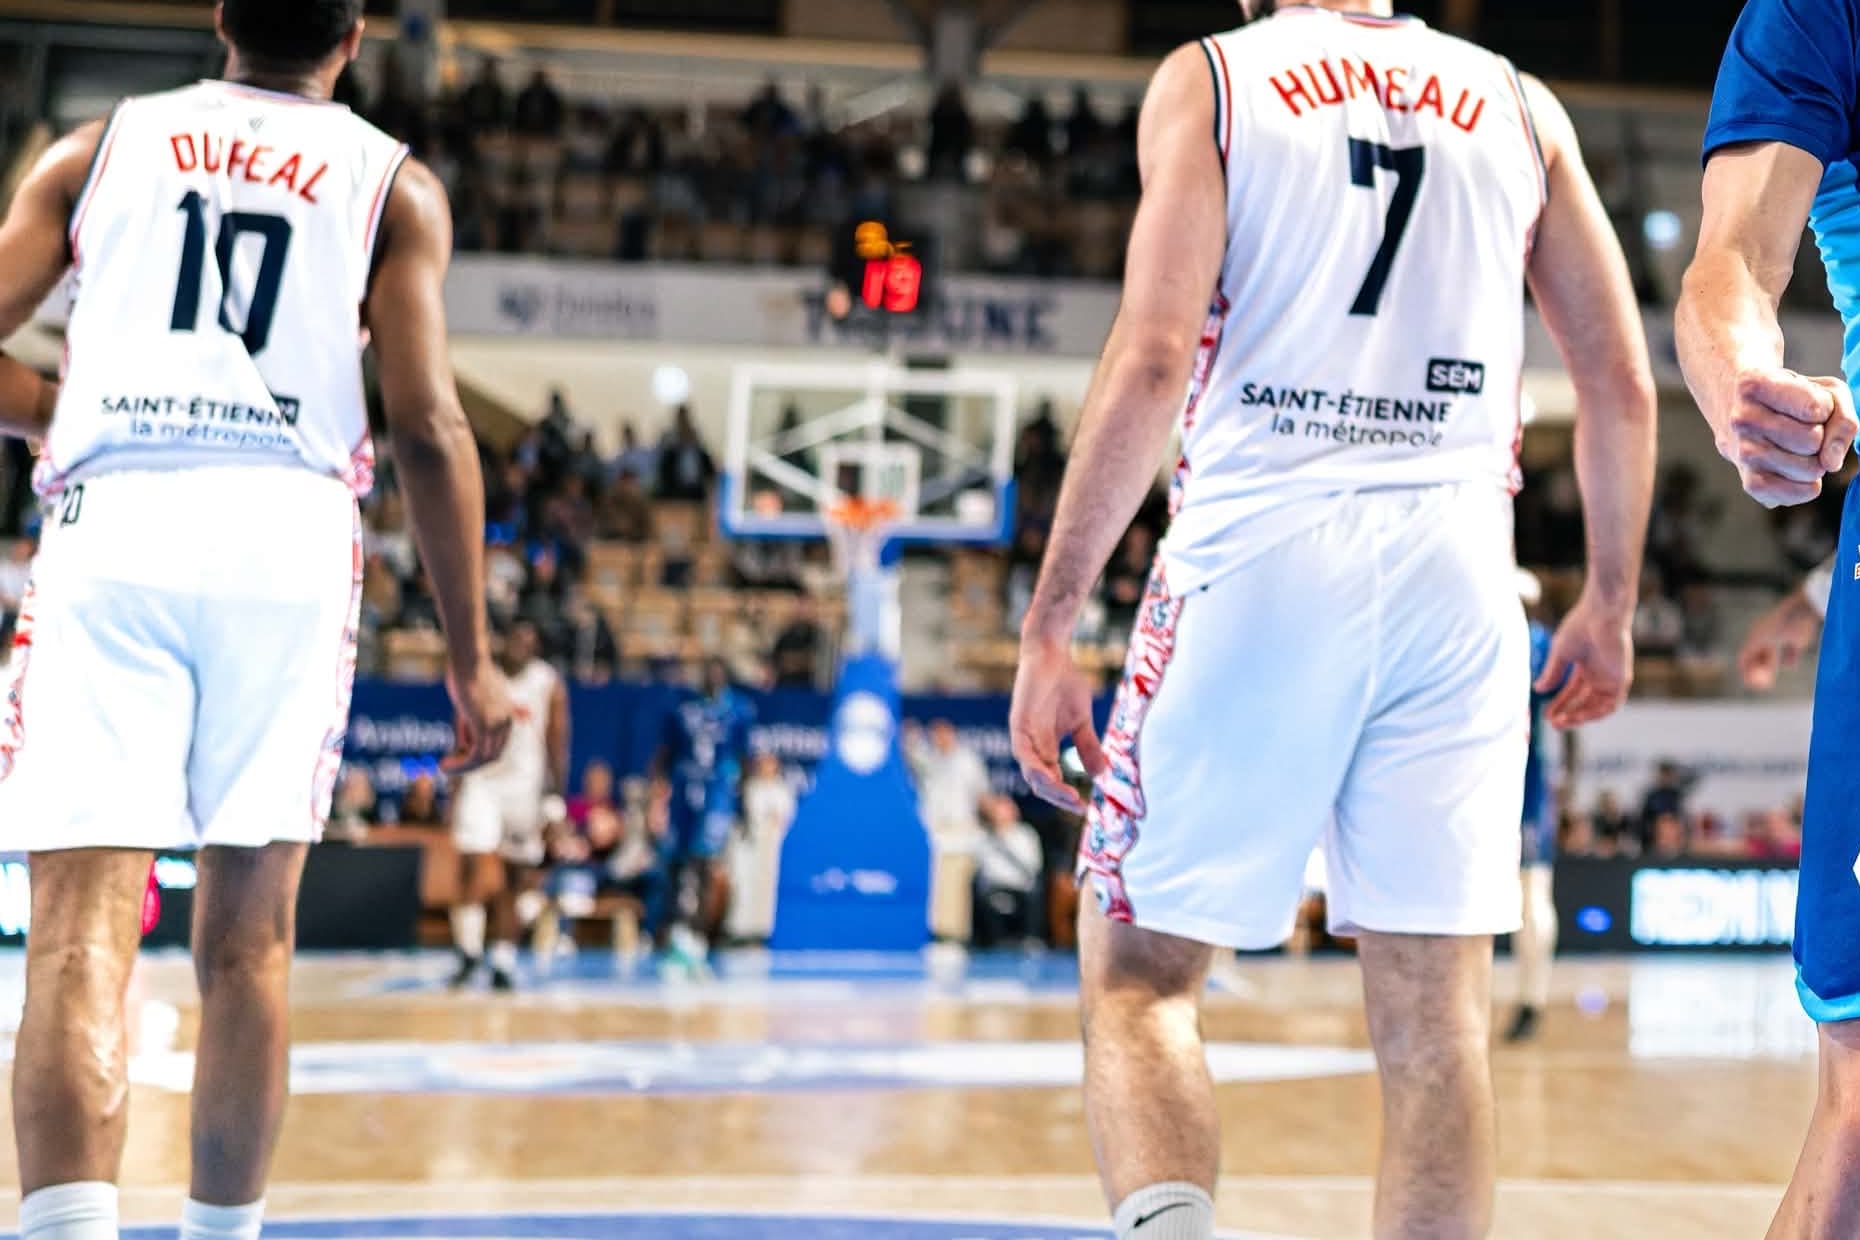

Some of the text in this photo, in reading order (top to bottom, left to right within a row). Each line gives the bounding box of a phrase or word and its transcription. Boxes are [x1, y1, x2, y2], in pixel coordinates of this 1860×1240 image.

[1269, 57, 1485, 133] HUMEAU
[170, 131, 328, 205] DUFEAL
[1347, 135, 1425, 317] 7
[170, 189, 293, 359] 10
[101, 395, 284, 426] SAINT-ÉTIENN
[1240, 382, 1452, 422] SAINT-ÉTIENNE
[1271, 412, 1443, 448] la métropoe
